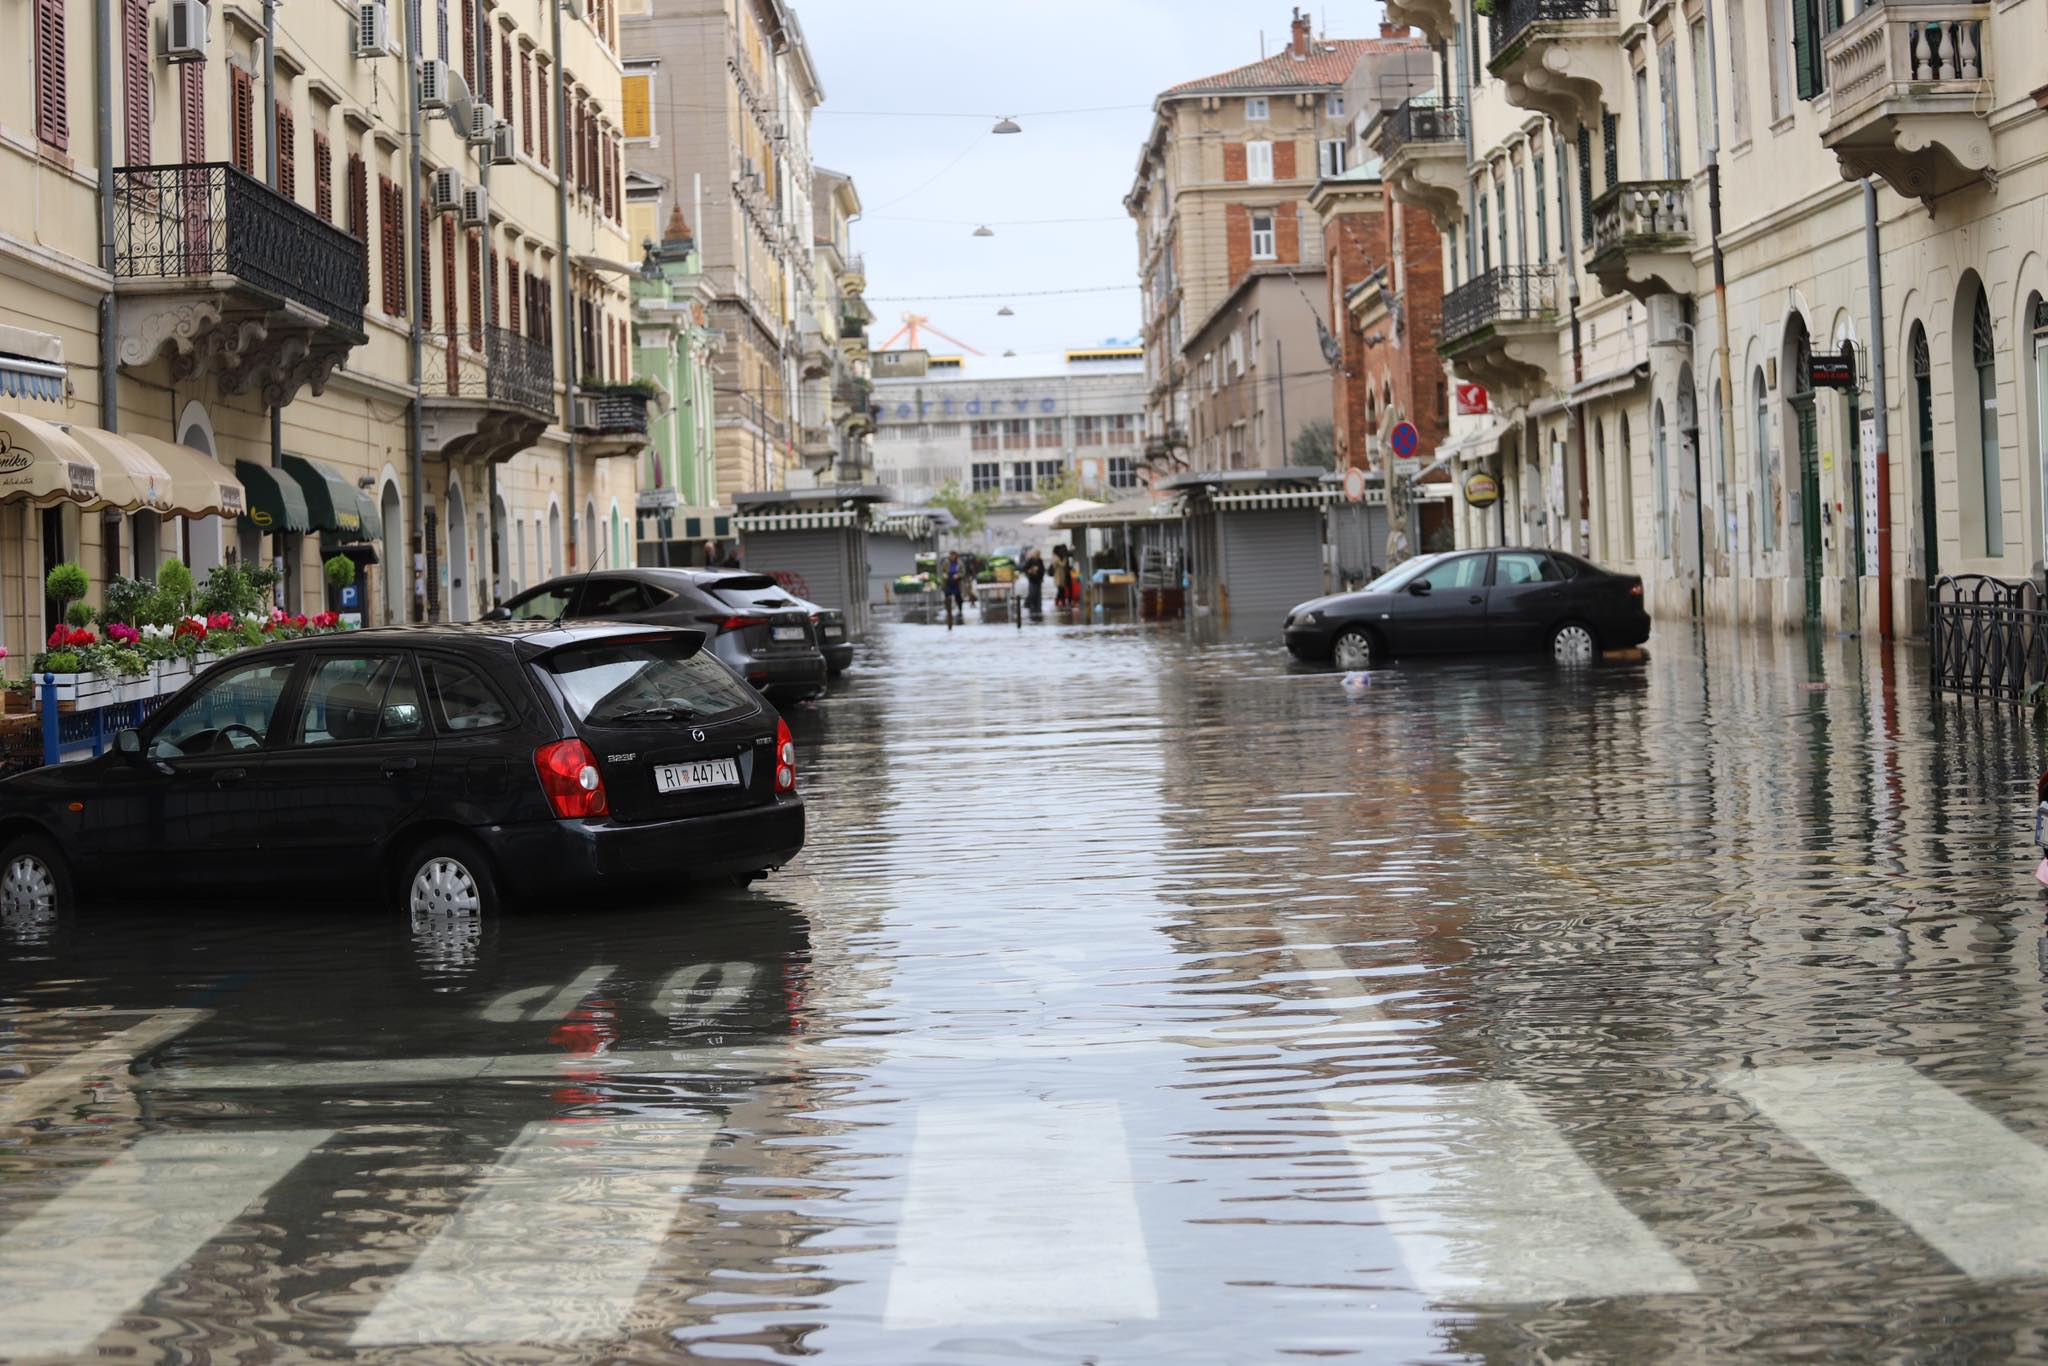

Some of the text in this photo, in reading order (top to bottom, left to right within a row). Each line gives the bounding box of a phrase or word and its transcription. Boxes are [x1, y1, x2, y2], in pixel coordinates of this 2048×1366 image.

[0, 454, 28, 468] nika
[342, 588, 355, 604] P
[608, 752, 636, 762] 323F
[664, 768, 681, 788] RI
